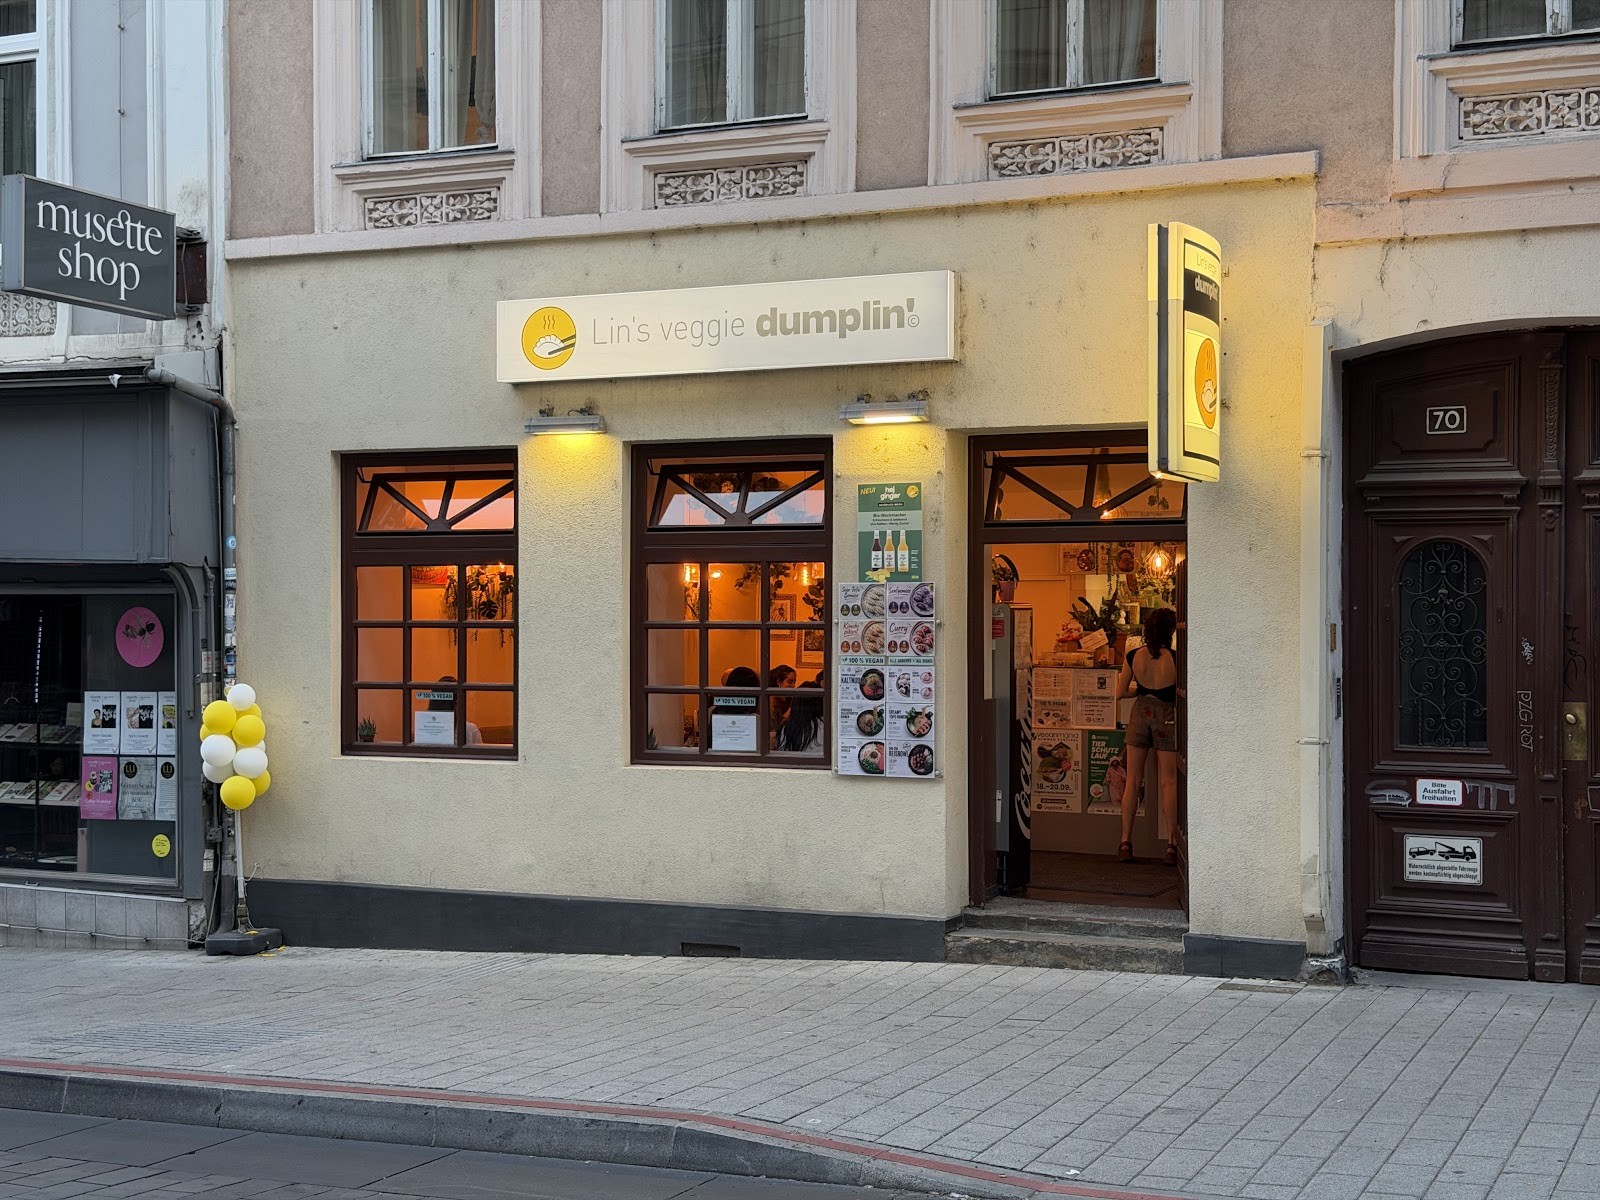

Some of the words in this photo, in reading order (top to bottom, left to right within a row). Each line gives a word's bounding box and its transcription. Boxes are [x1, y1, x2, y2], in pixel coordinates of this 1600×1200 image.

[37, 200, 163, 255] musette
[58, 241, 140, 301] shop
[592, 316, 650, 345] Lin's
[660, 310, 745, 347] veggie
[1433, 410, 1460, 429] 70
[885, 486, 895, 494] hej
[880, 492, 901, 501] ginger
[889, 623, 908, 633] Curry
[1091, 746, 1119, 754] SCHUTZ
[1422, 787, 1456, 795] Ausfahrt
[1421, 793, 1457, 802] freihalten
[1436, 864, 1457, 872] abgestellte
[1423, 871, 1451, 879] kostenpflichtig
